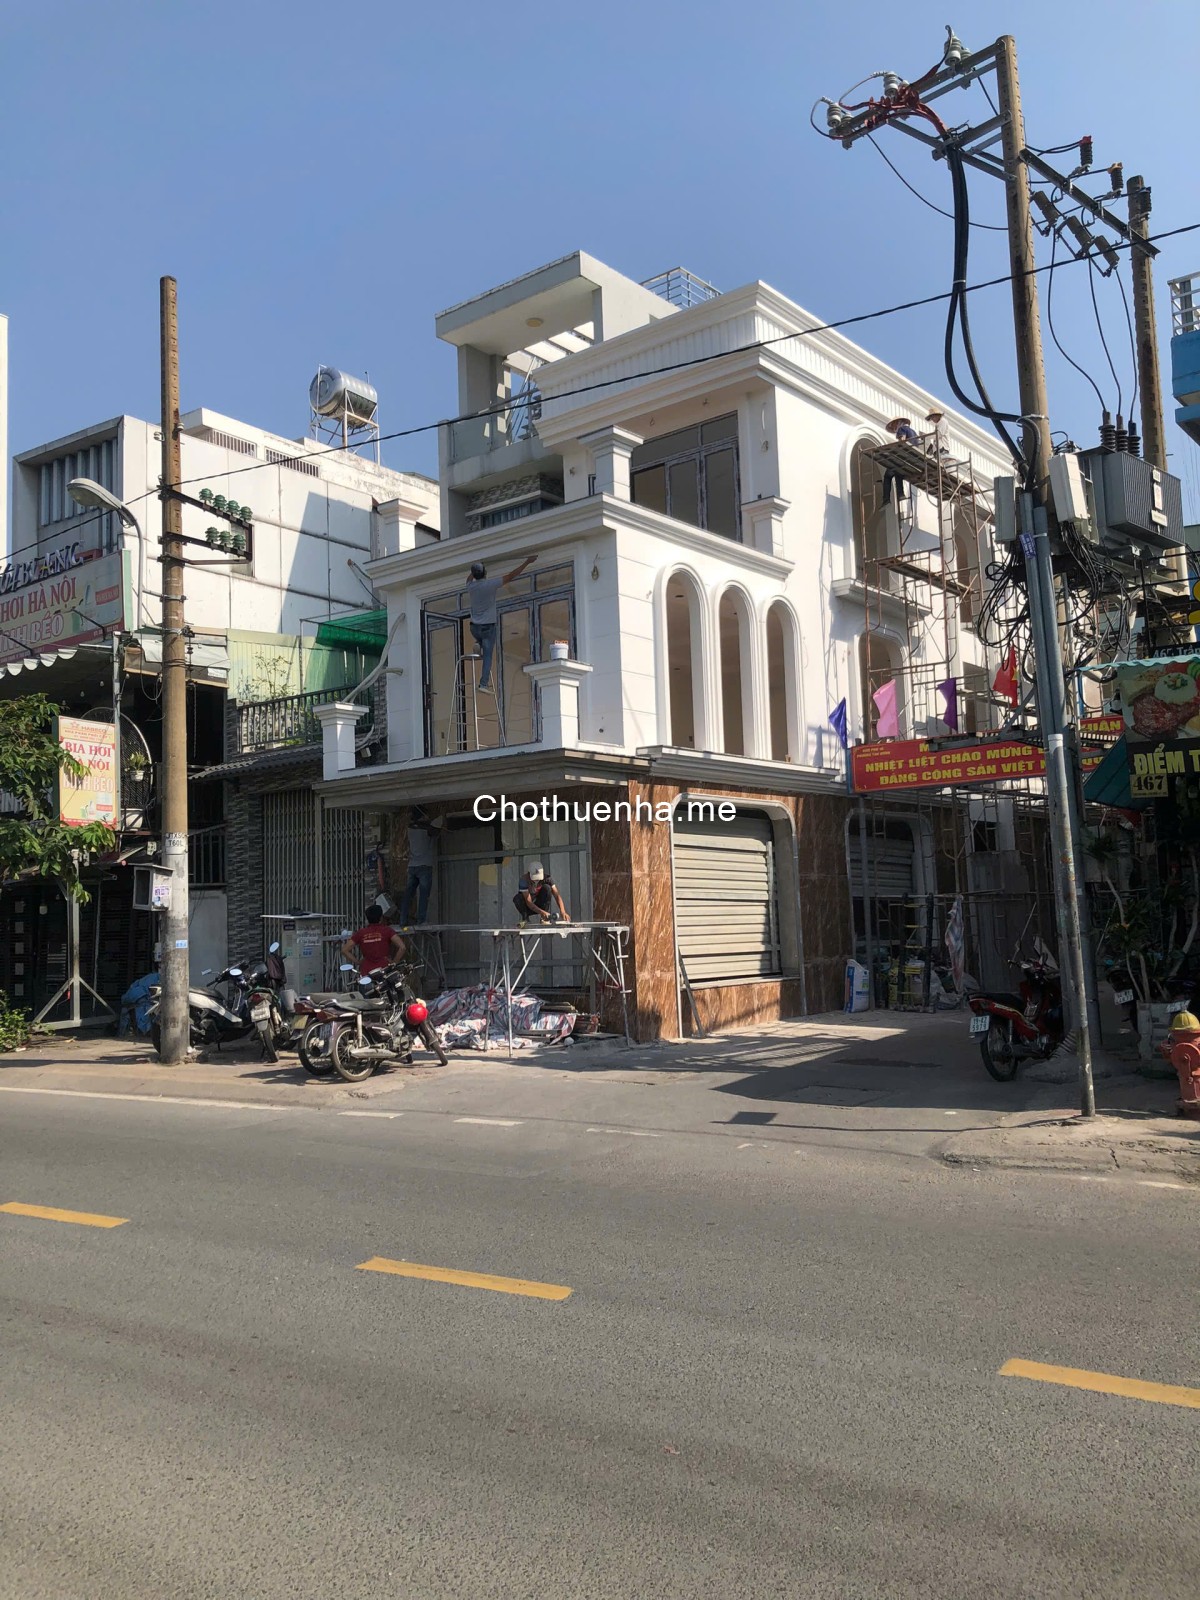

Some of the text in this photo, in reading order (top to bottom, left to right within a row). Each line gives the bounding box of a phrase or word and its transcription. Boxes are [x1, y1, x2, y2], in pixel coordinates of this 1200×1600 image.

[28, 583, 47, 614] HÀ
[50, 575, 76, 609] NỘI
[30, 611, 65, 644] BÉO
[65, 741, 111, 758] BIA HƠI
[865, 759, 904, 773] NHIỆT
[908, 755, 937, 768] LIỆT
[941, 751, 981, 764] CHÀO
[987, 746, 1032, 759] MỪNG
[1133, 743, 1186, 776] ĐIỂM
[88, 758, 110, 772] NỘI
[879, 772, 918, 785] ĐẢNG
[921, 768, 962, 781] CỘNG
[966, 764, 997, 776] SẢN
[1001, 760, 1035, 773] VIỆT
[1132, 775, 1164, 791] 467
